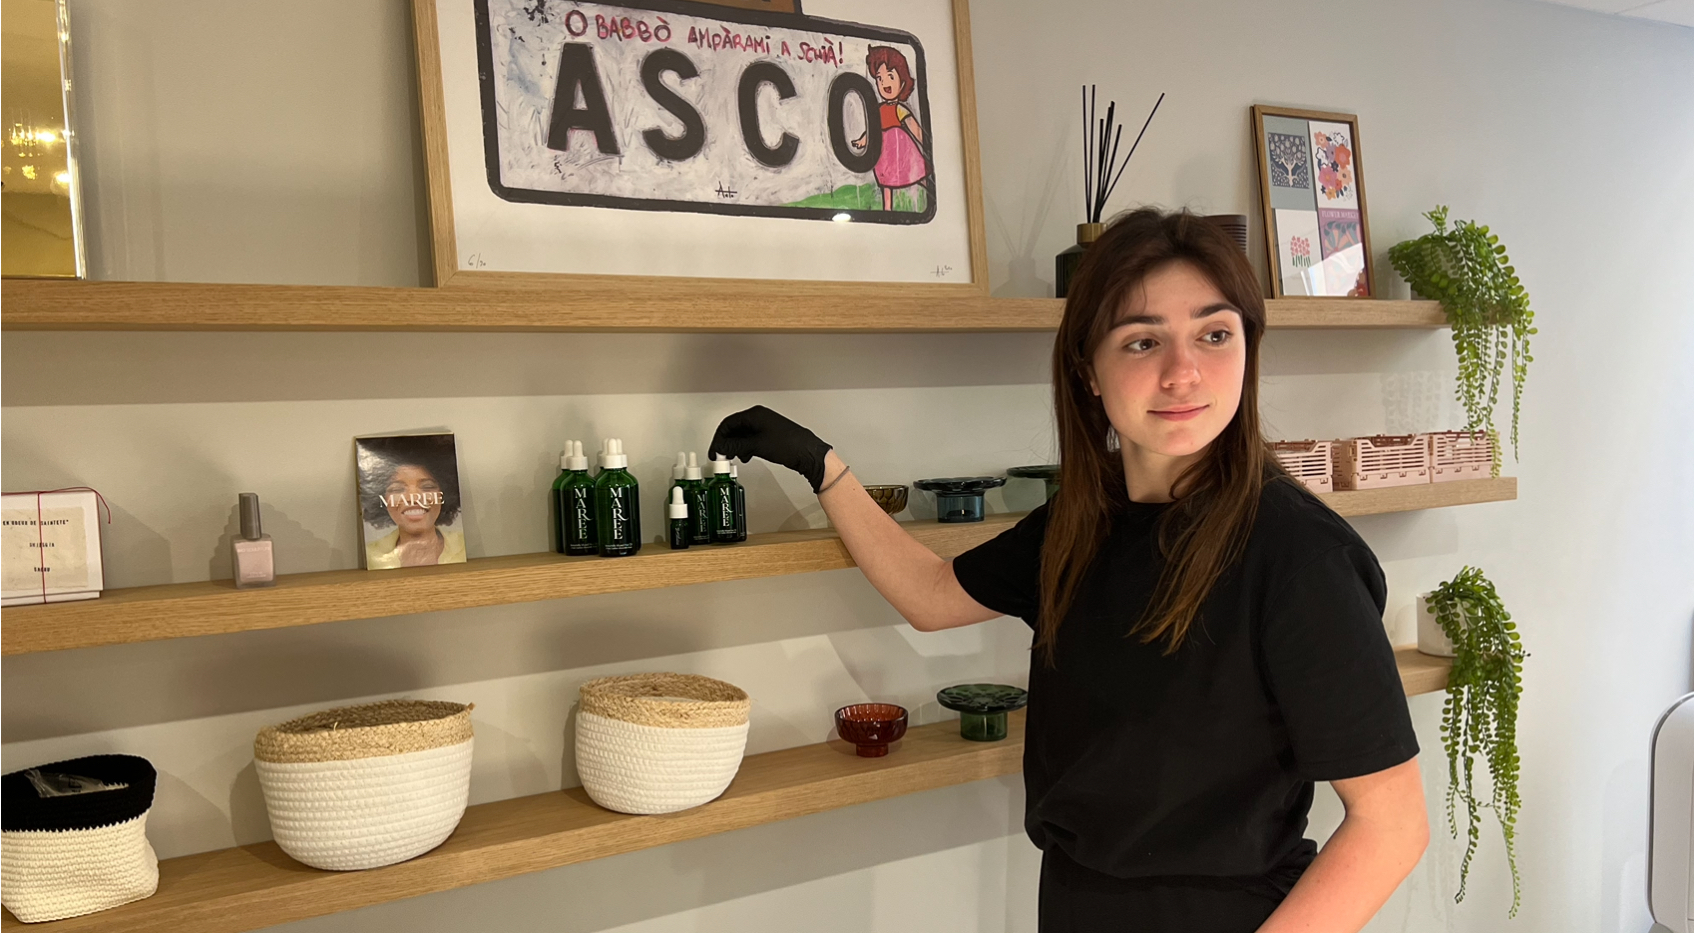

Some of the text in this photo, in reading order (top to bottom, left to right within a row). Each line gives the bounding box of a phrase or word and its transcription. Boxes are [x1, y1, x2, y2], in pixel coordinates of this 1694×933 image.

[565, 10, 588, 37] O
[781, 41, 791, 57] A
[547, 42, 882, 174] ASCO
[379, 491, 445, 510] MAREE
[574, 487, 594, 540] MAREE
[609, 487, 629, 540] MAREE
[720, 487, 734, 527] MAREE
